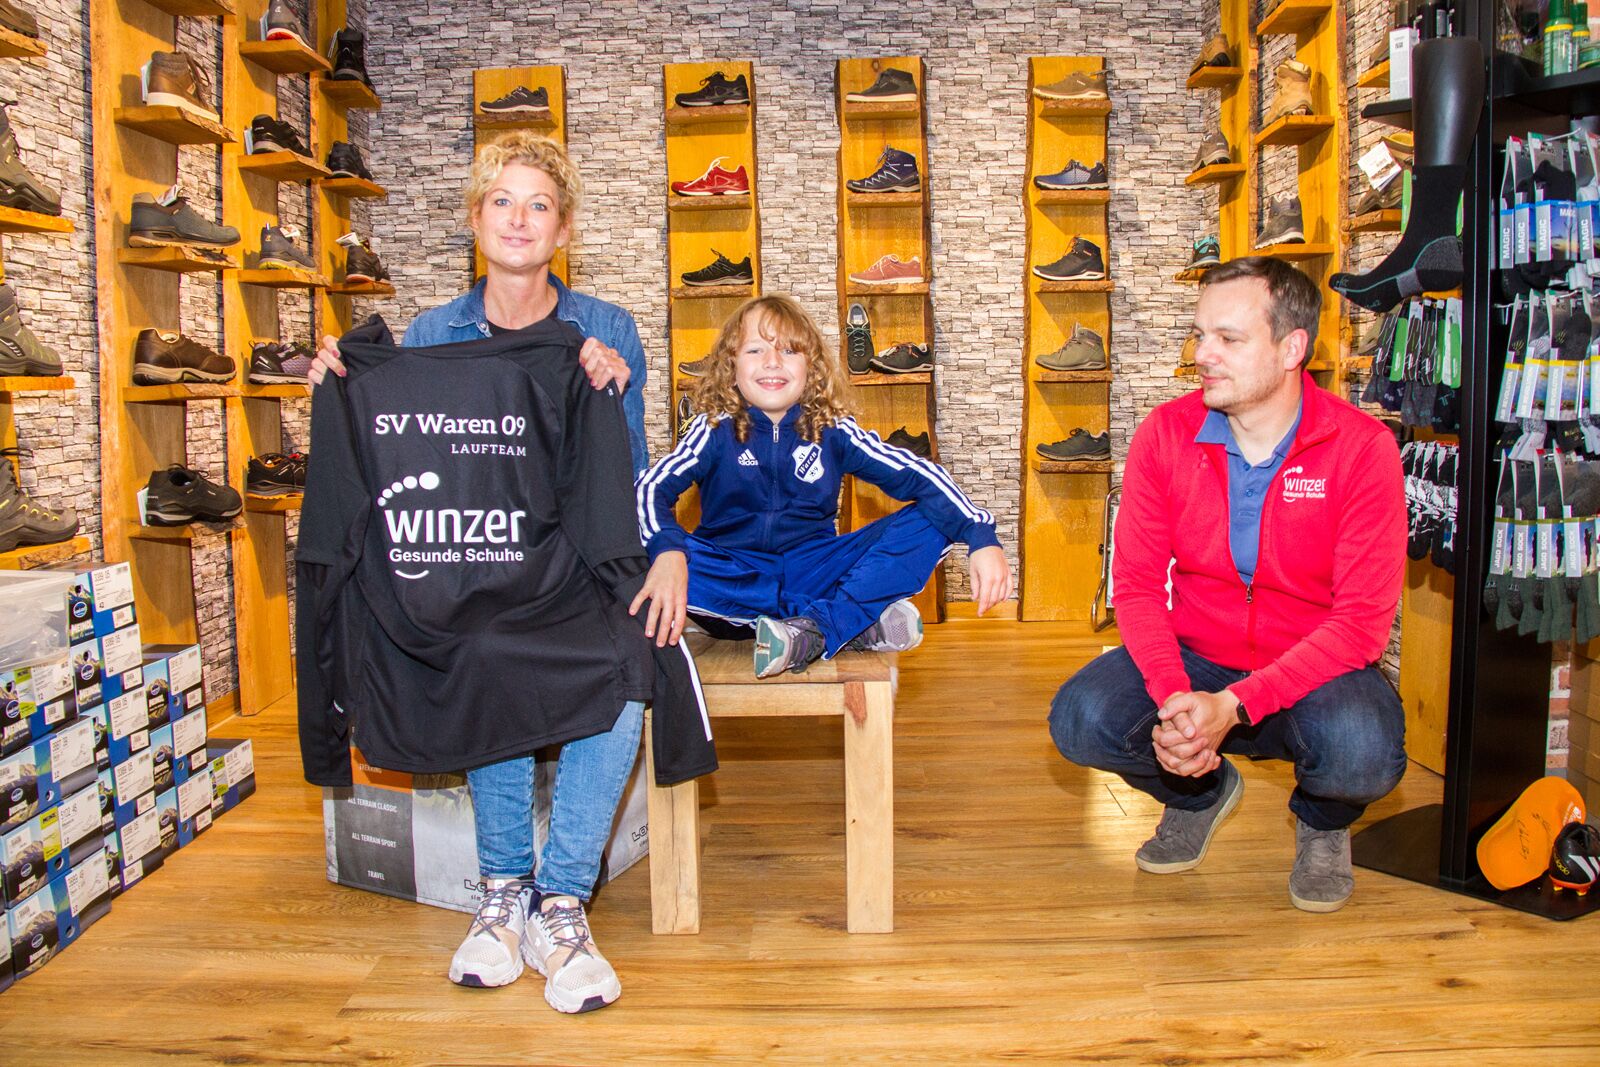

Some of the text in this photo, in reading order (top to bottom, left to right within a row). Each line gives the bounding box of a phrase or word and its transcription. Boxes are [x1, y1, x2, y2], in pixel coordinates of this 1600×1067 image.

[1502, 227, 1511, 259] MAGIC
[1517, 221, 1526, 254] MAGIC
[1539, 218, 1548, 251] MAGIC
[1581, 218, 1590, 251] MAGIC
[375, 413, 526, 436] SV Waren 09
[451, 443, 527, 457] LAUFTEAM
[389, 548, 524, 562] Gesunde Schuhe
[368, 870, 385, 880] TRAVEL
